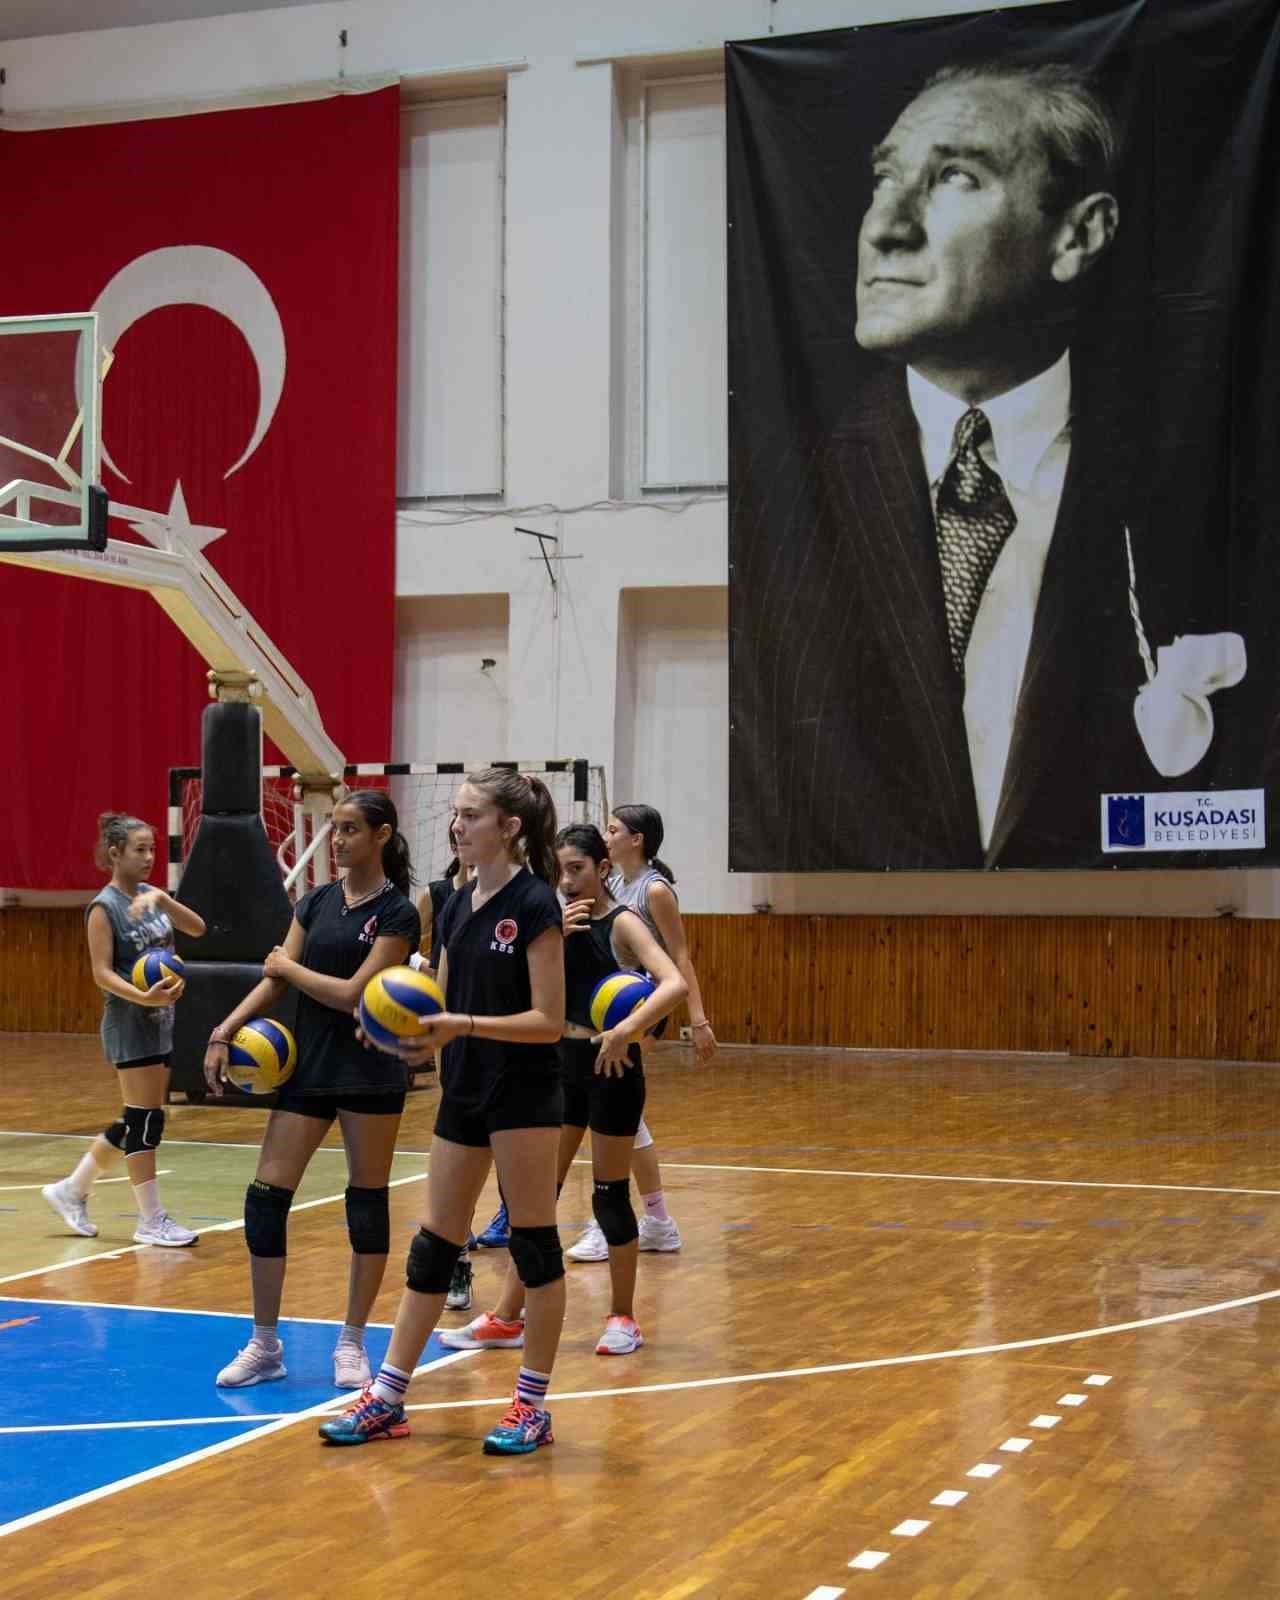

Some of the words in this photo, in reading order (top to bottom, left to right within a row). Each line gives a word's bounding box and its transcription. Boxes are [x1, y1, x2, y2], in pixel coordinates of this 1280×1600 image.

[1154, 809, 1255, 827] KUŞADASI
[1154, 826, 1255, 842] BELEDİYESİ
[490, 941, 514, 954] KBS
